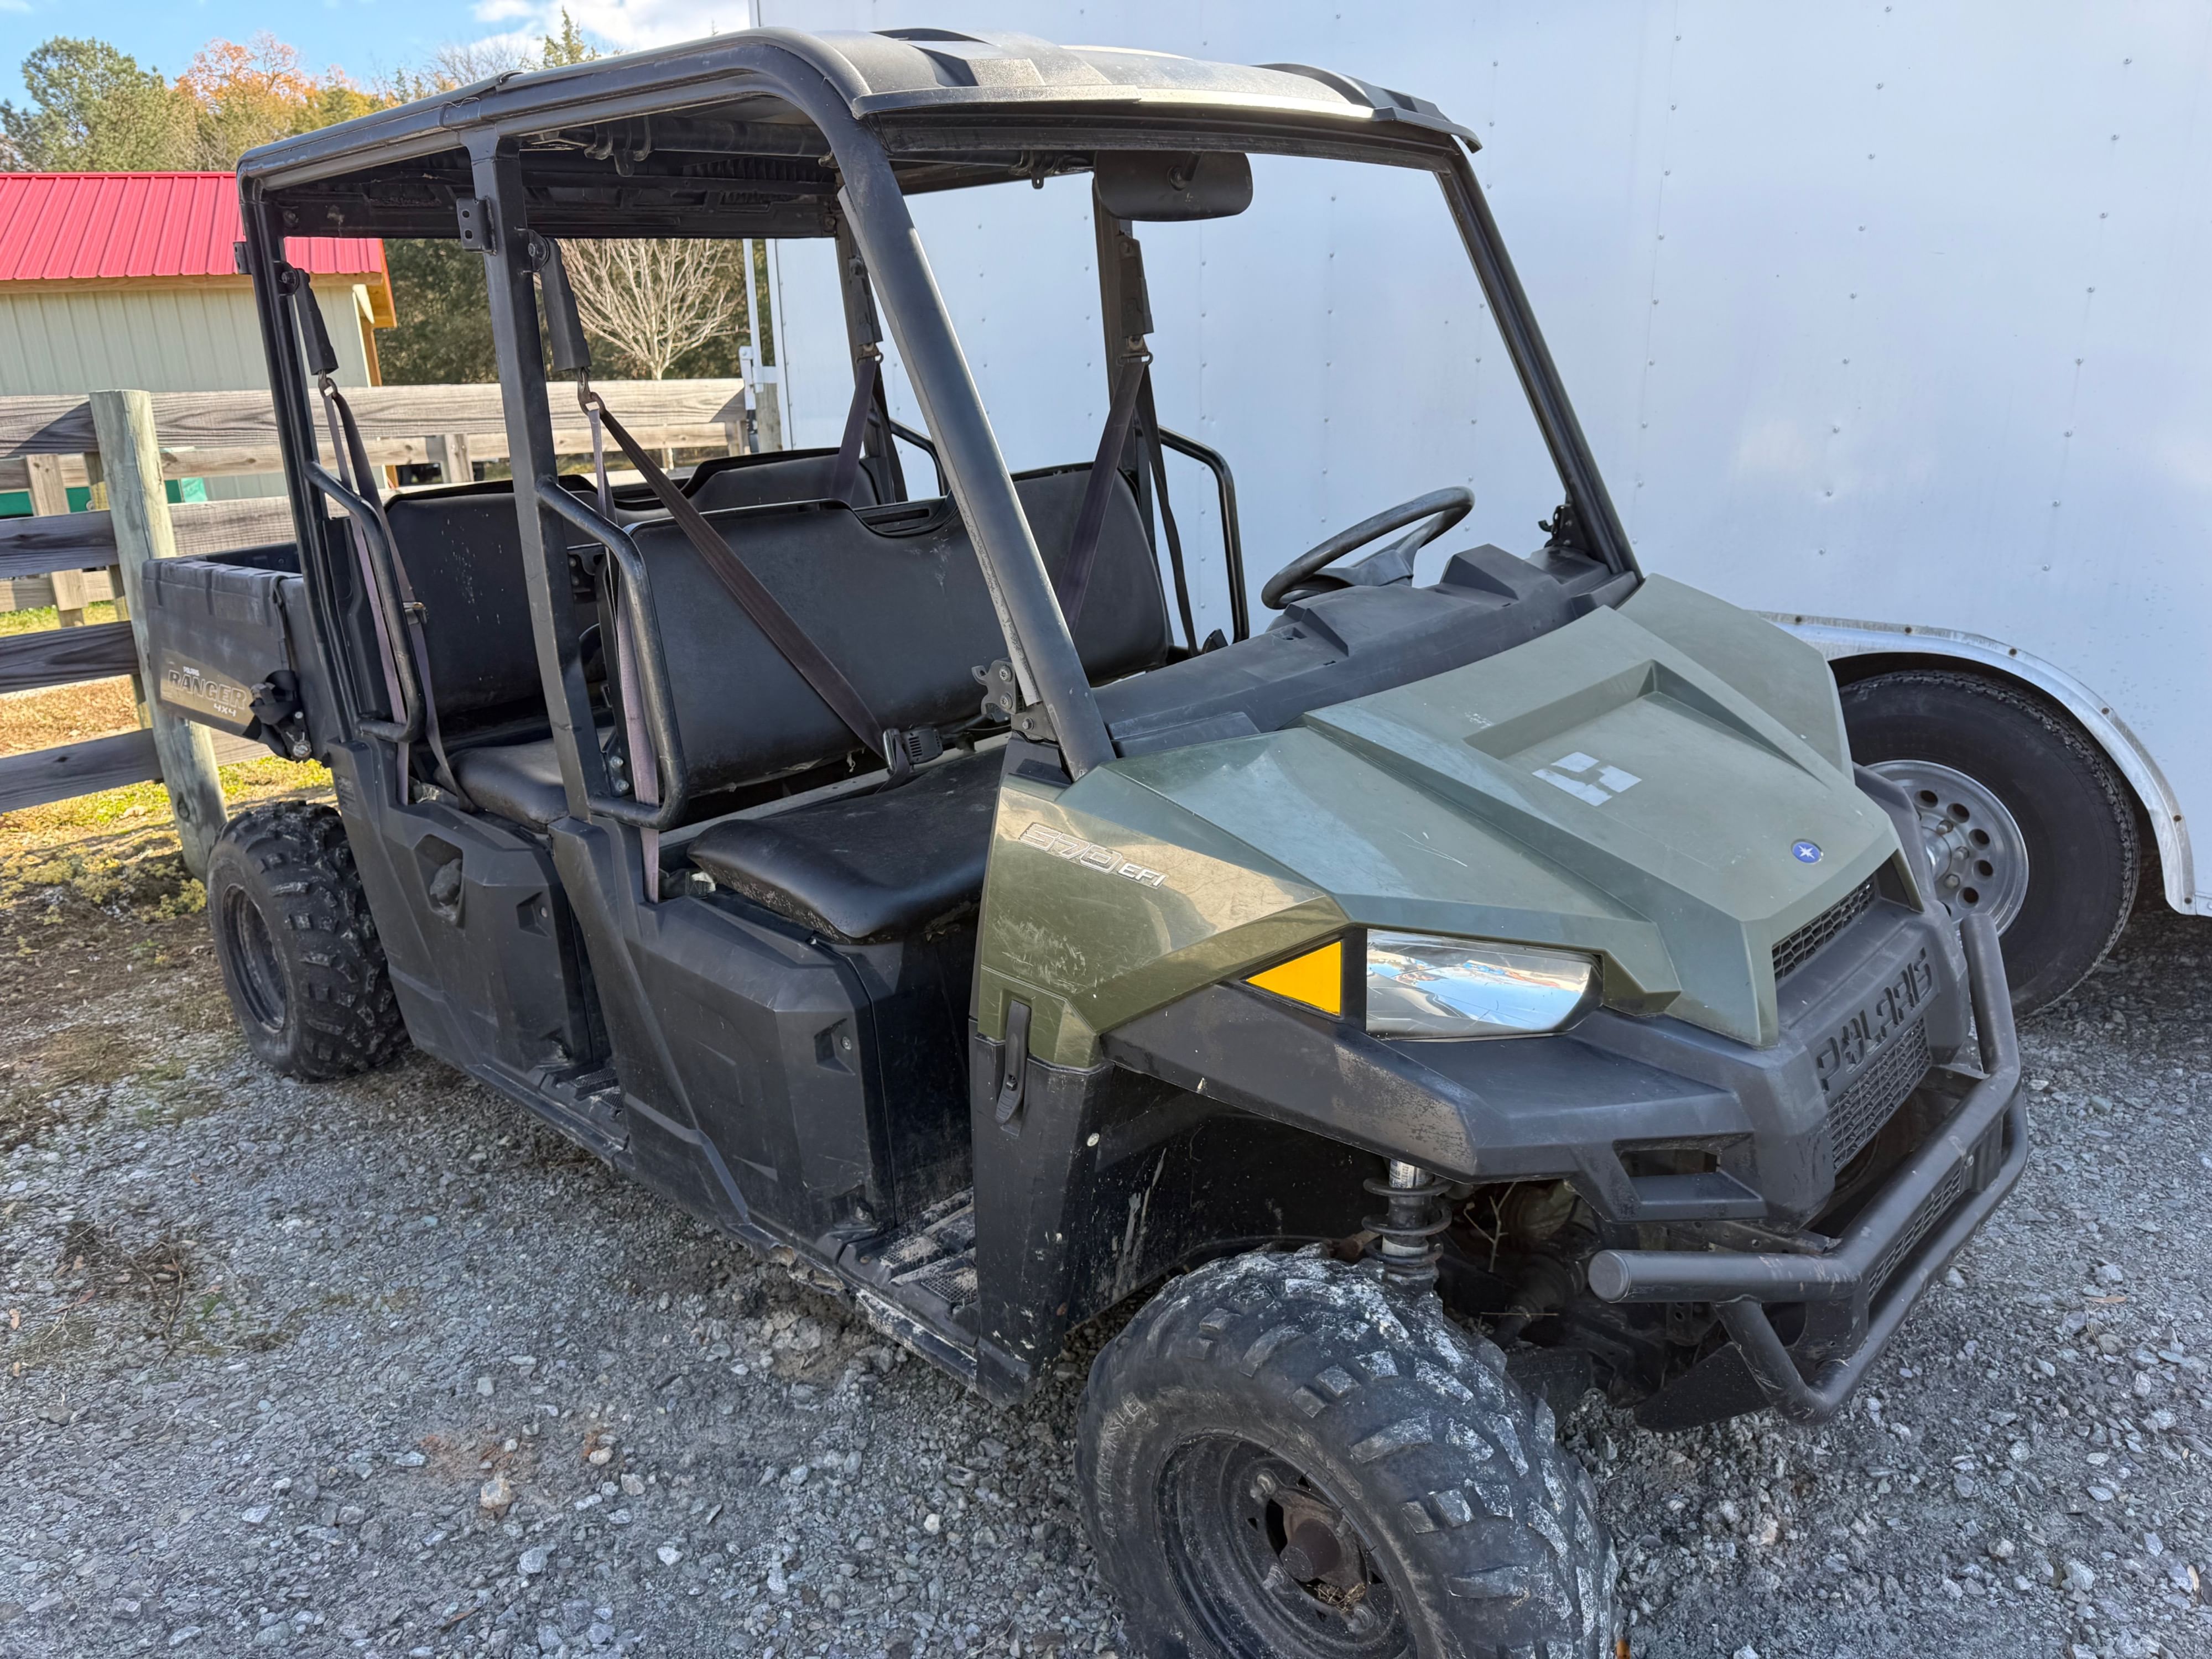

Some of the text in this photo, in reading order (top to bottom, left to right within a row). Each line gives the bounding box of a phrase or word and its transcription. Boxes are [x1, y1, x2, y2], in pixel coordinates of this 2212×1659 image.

[168, 670, 247, 709] RANGER
[1018, 822, 1168, 886] 570 EFI
[1816, 947, 1933, 1095] POLARIS
